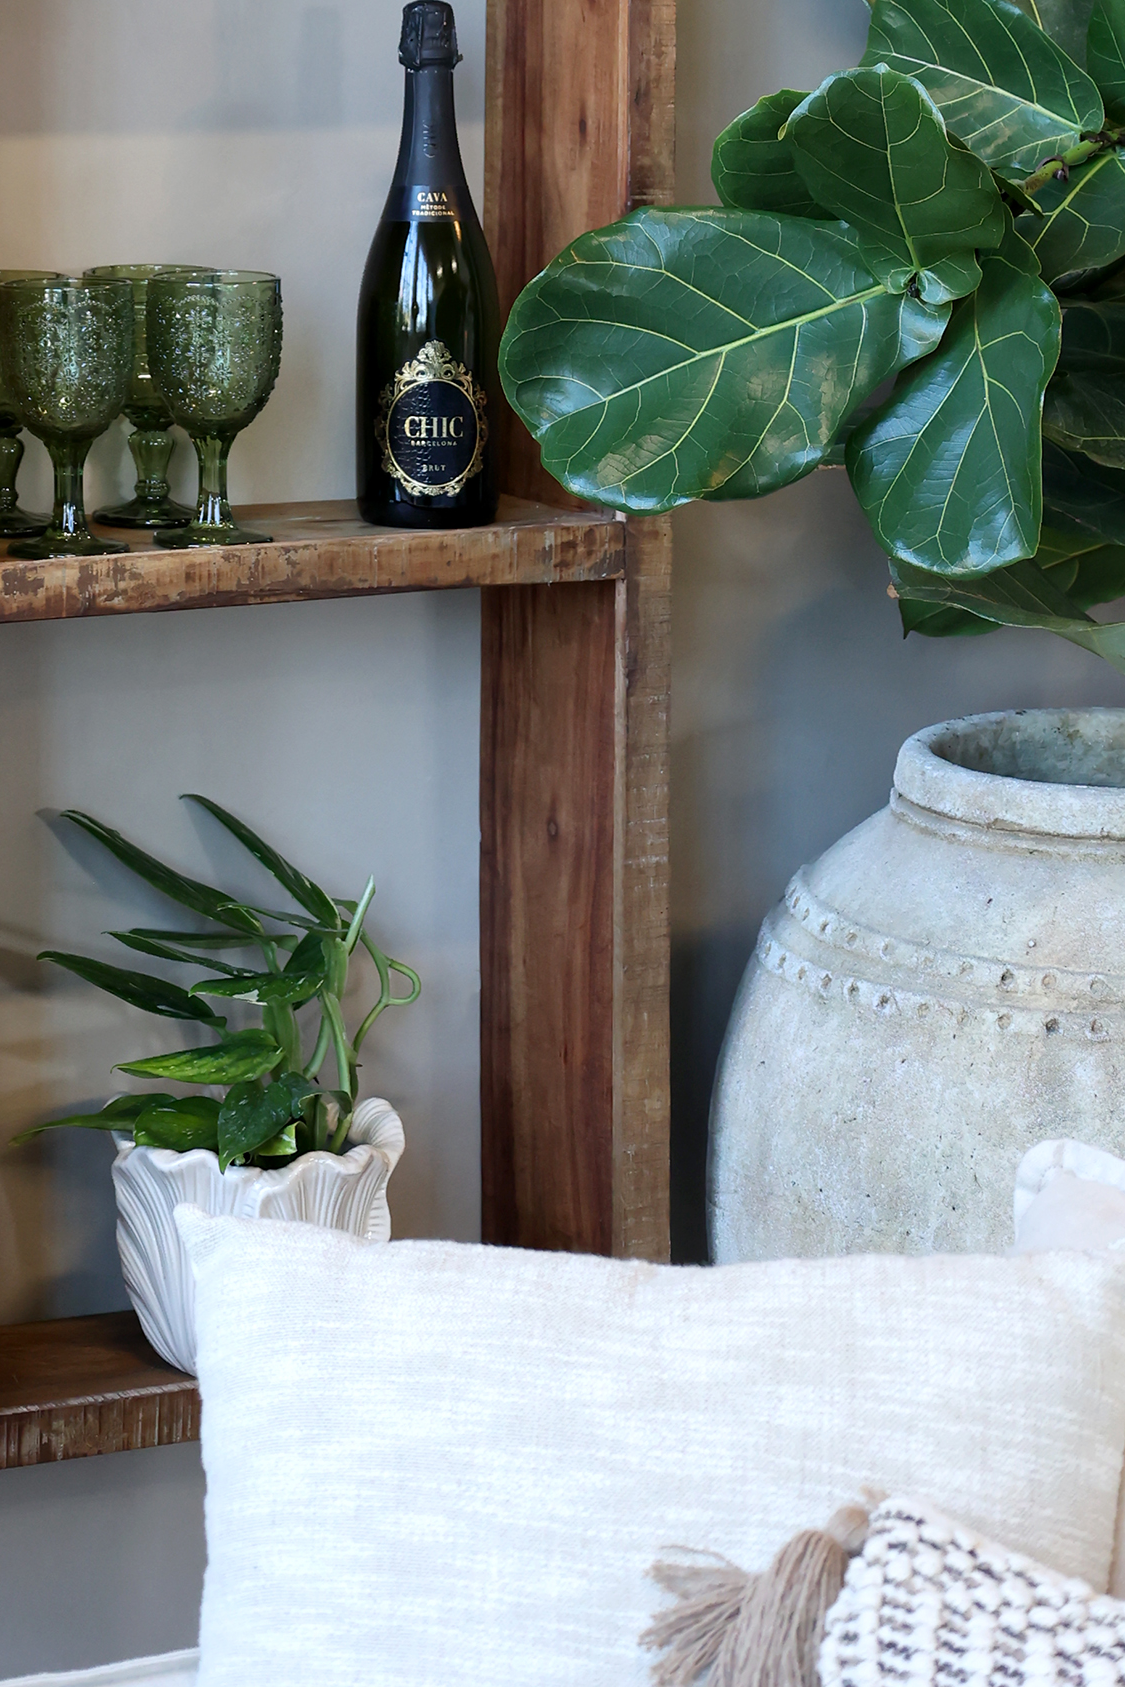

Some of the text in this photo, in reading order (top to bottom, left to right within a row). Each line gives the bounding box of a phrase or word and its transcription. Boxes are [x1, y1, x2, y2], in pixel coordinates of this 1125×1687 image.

[417, 192, 448, 203] CAVA
[404, 415, 464, 439] CHIC
[422, 464, 446, 472] BRUT
